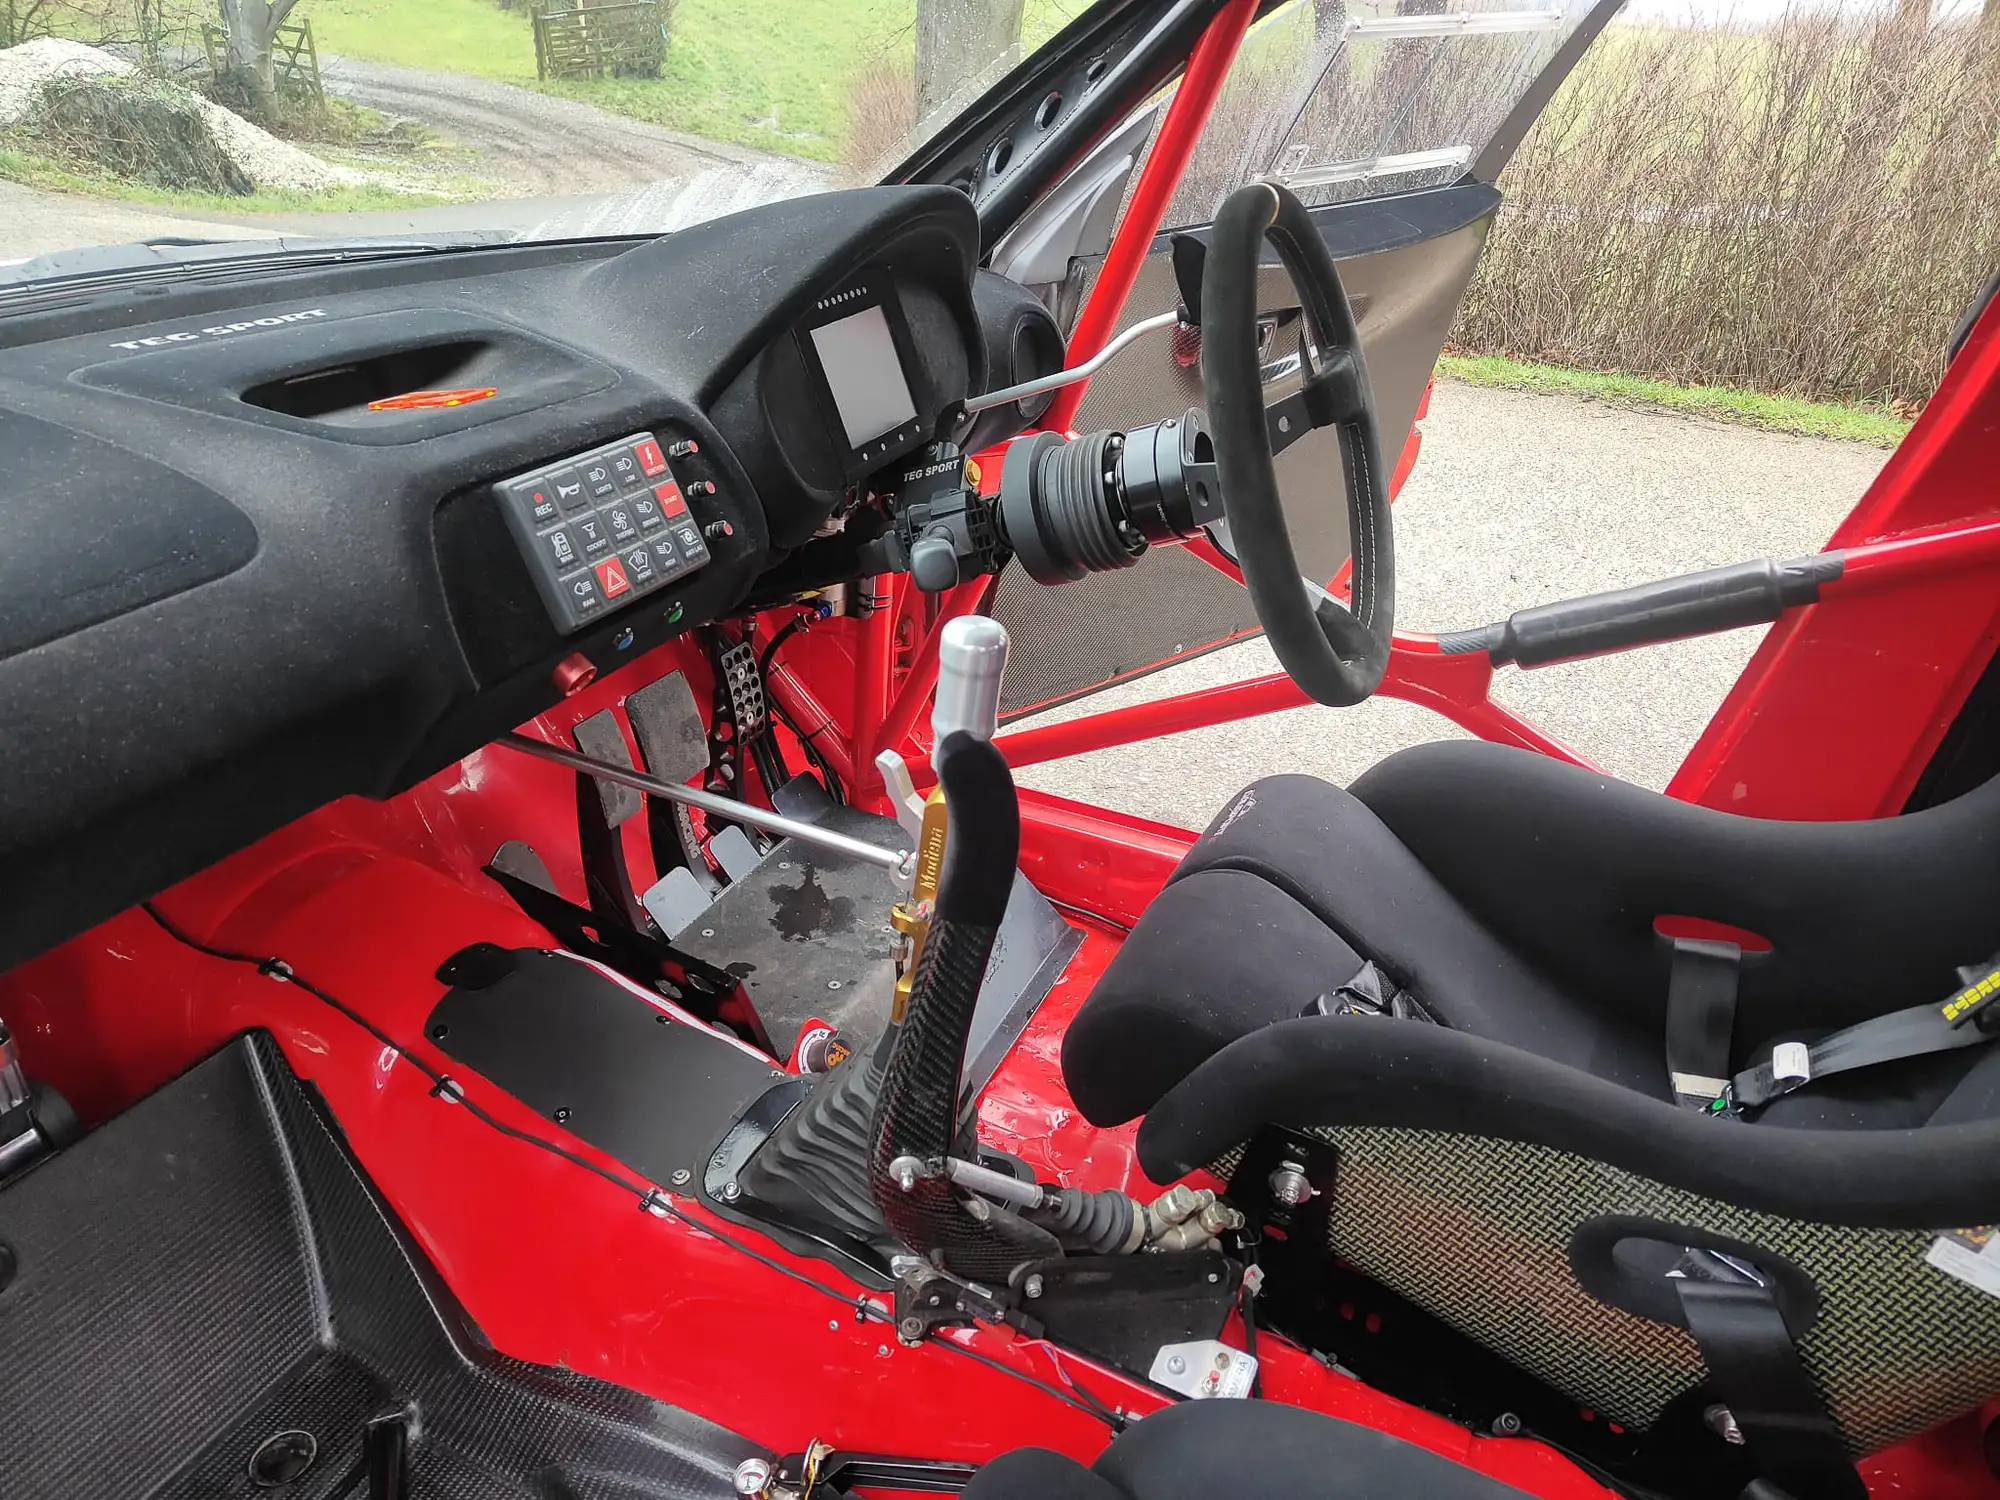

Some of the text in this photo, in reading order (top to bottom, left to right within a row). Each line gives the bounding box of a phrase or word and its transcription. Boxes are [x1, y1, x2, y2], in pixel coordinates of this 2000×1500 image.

[201, 307, 328, 336] SPORT
[925, 458, 960, 477] SPORT
[624, 473, 636, 483] LOW
[595, 483, 612, 494] LIGHTS
[664, 494, 678, 505] START
[534, 502, 553, 517] REC
[586, 538, 607, 552] COCKPIT
[676, 801, 701, 859] RACING
